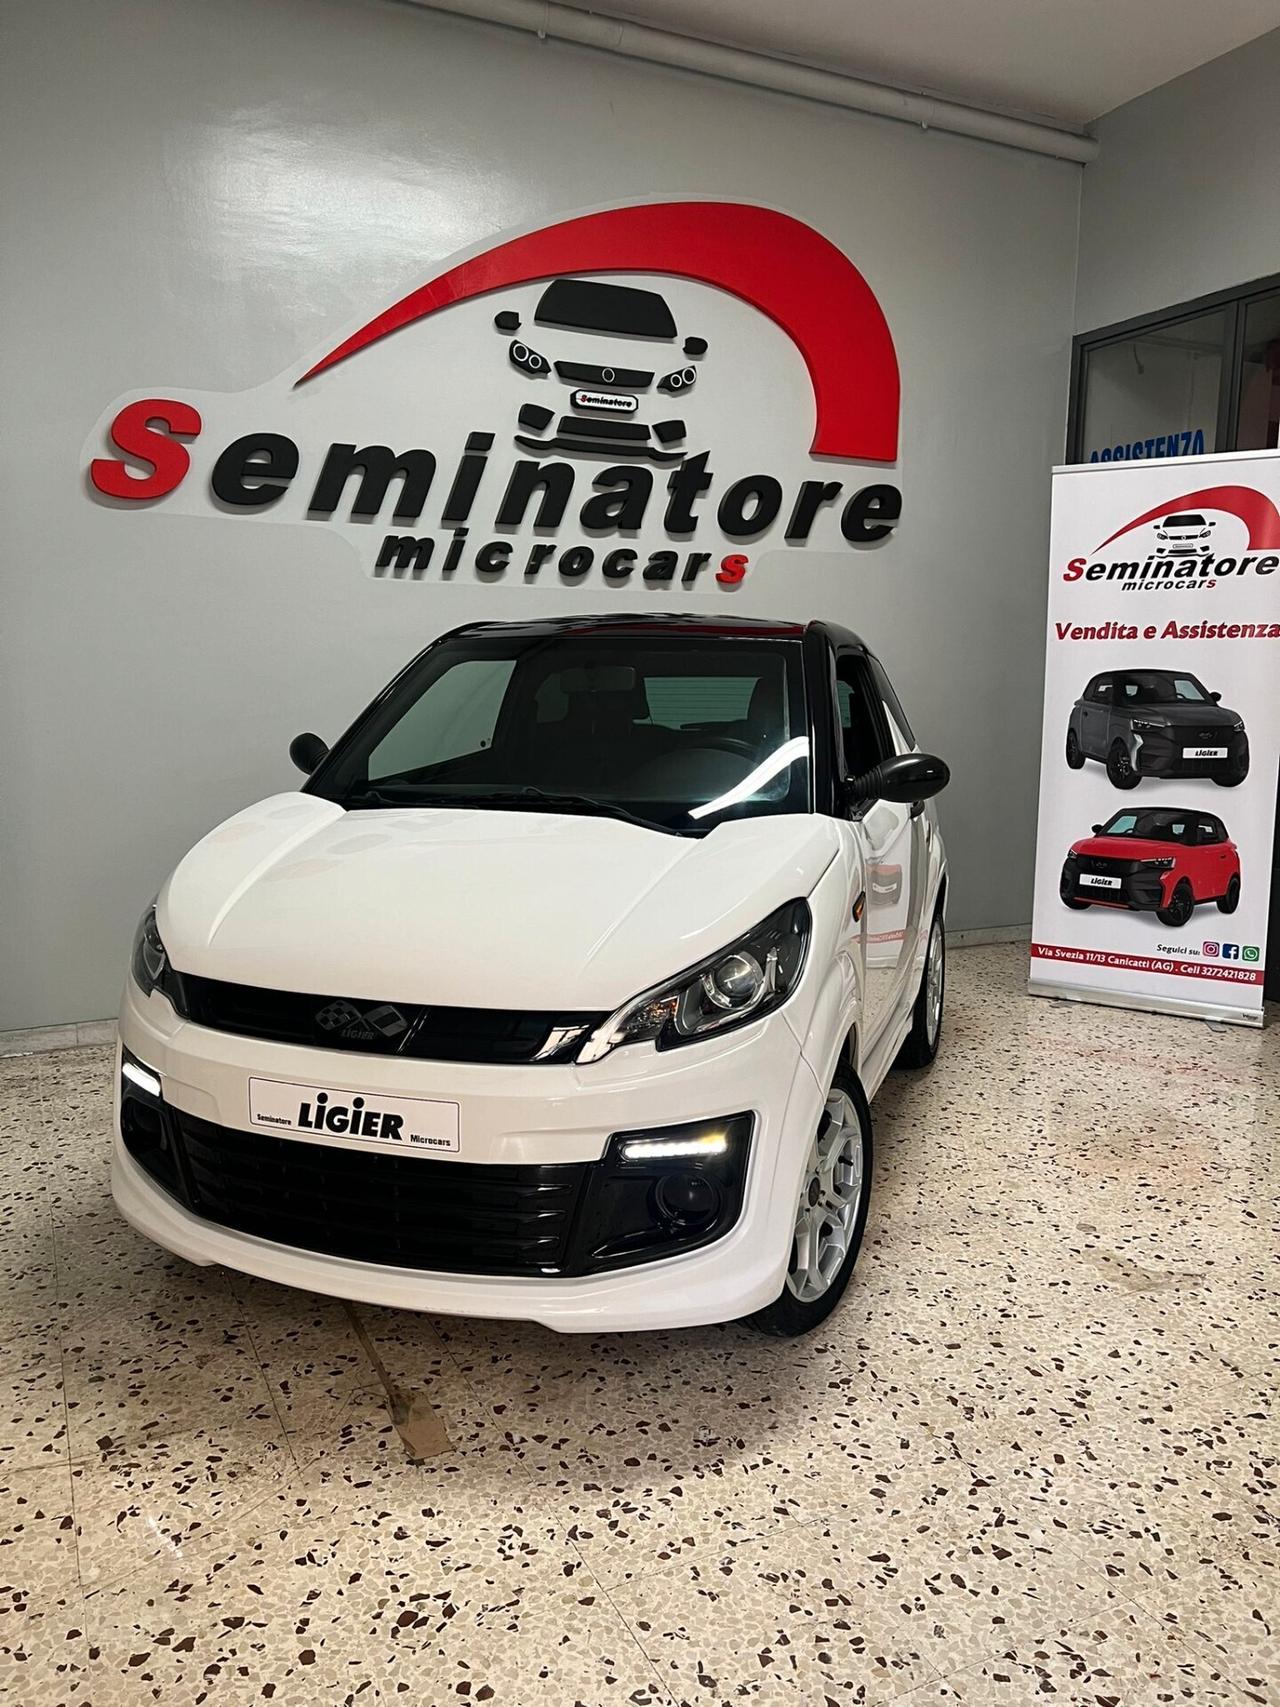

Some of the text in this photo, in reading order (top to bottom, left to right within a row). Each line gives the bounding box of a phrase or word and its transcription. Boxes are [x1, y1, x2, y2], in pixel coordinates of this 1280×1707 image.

[580, 394, 632, 408] Seminatore
[90, 398, 903, 543] Seminatore
[374, 530, 748, 588] microcars
[1063, 551, 1279, 581] Seminatore
[1121, 578, 1217, 591] microcars
[1055, 620, 1280, 640] Vendita e Assistenza
[1038, 947, 1053, 956] Via
[1055, 949, 1084, 960] Svezia
[1086, 953, 1106, 962] 11/13
[1151, 960, 1174, 972] (AG)
[1180, 964, 1200, 974] Cell
[1201, 967, 1256, 981] 3272421828
[1157, 944, 1187, 954] Seguici
[257, 1113, 292, 1126] Seminatore
[410, 1134, 451, 1147] Microcars
